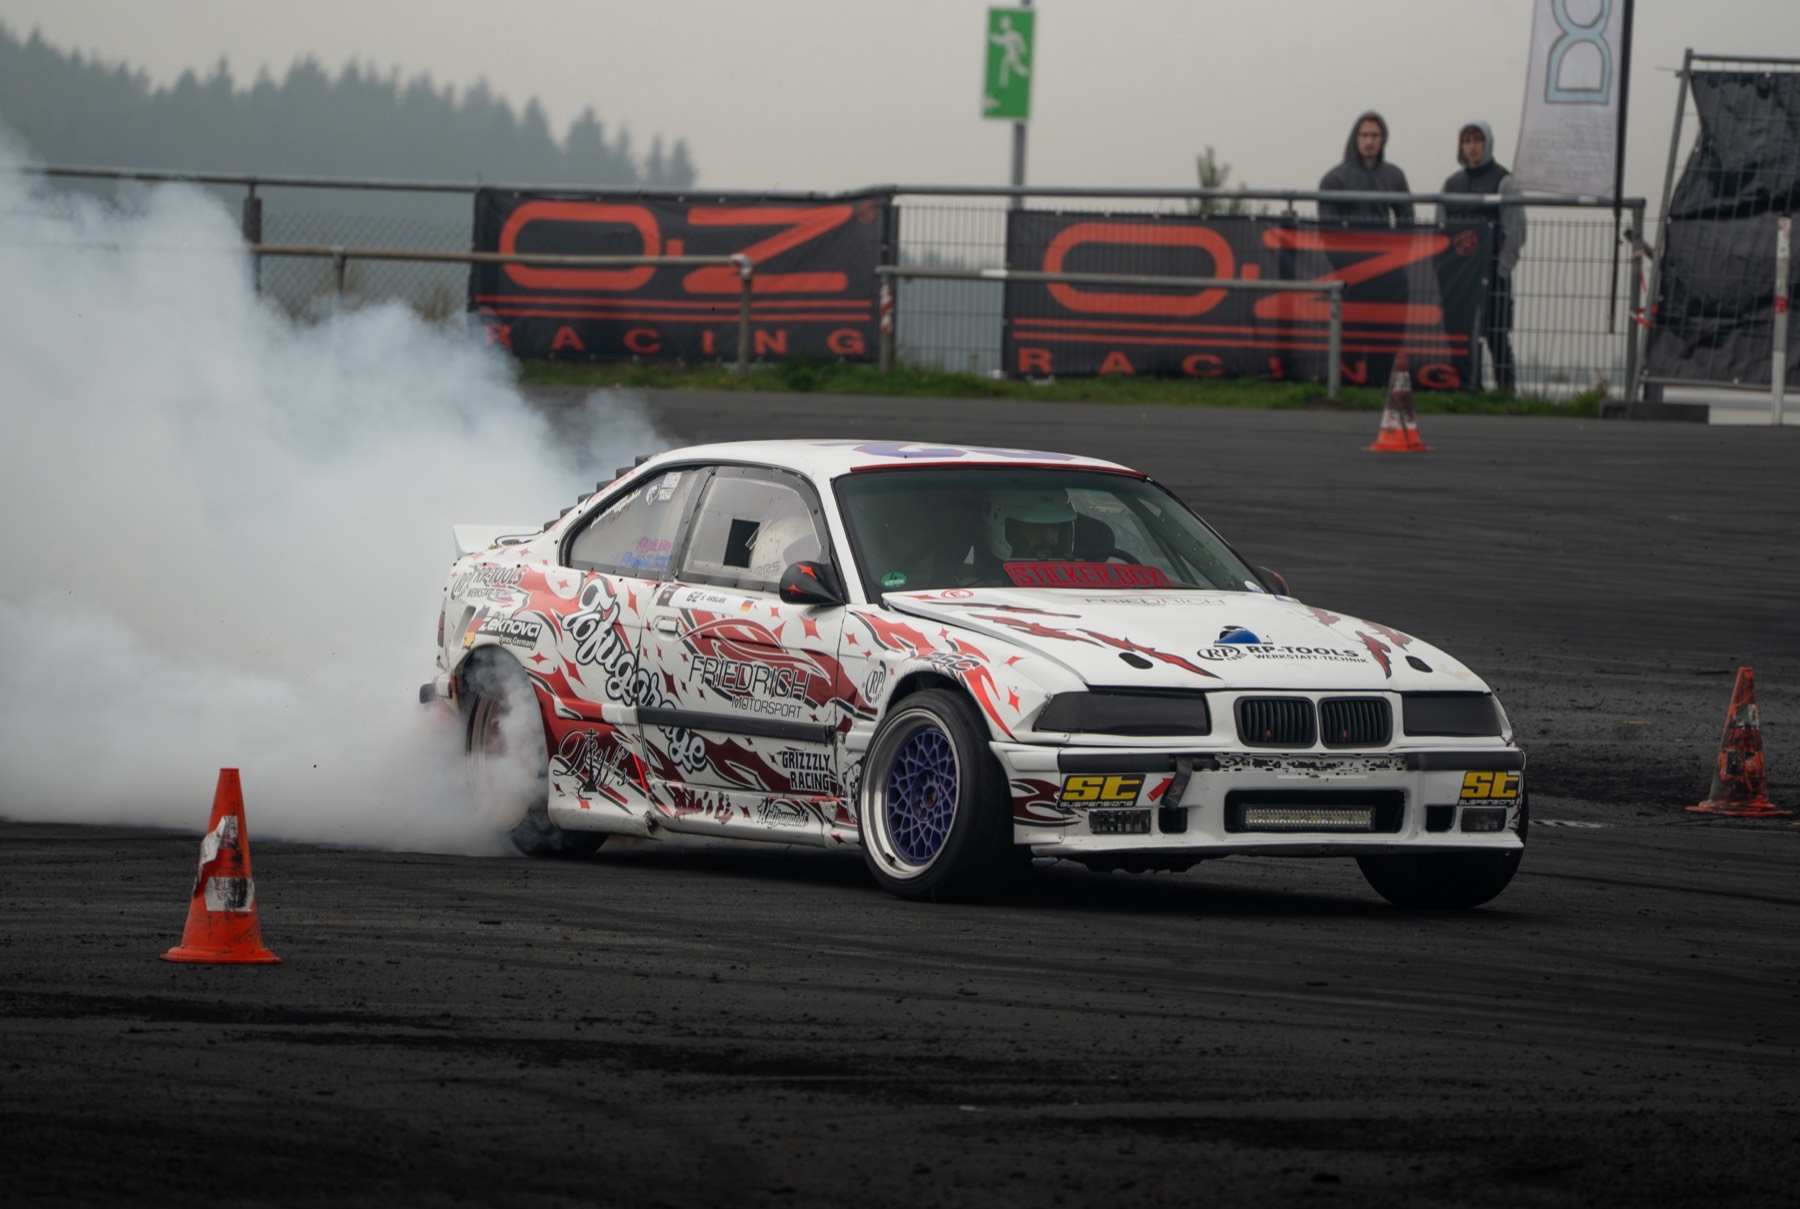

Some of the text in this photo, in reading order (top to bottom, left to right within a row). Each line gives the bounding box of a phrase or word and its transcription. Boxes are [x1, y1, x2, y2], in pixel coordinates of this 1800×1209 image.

[1246, 645, 1359, 657] RP-TOOLS
[688, 655, 810, 700] FRIEDRICH
[731, 697, 802, 718] MOTORSPORT
[781, 751, 830, 772] GRIZZZLY
[789, 771, 830, 791] RACING
